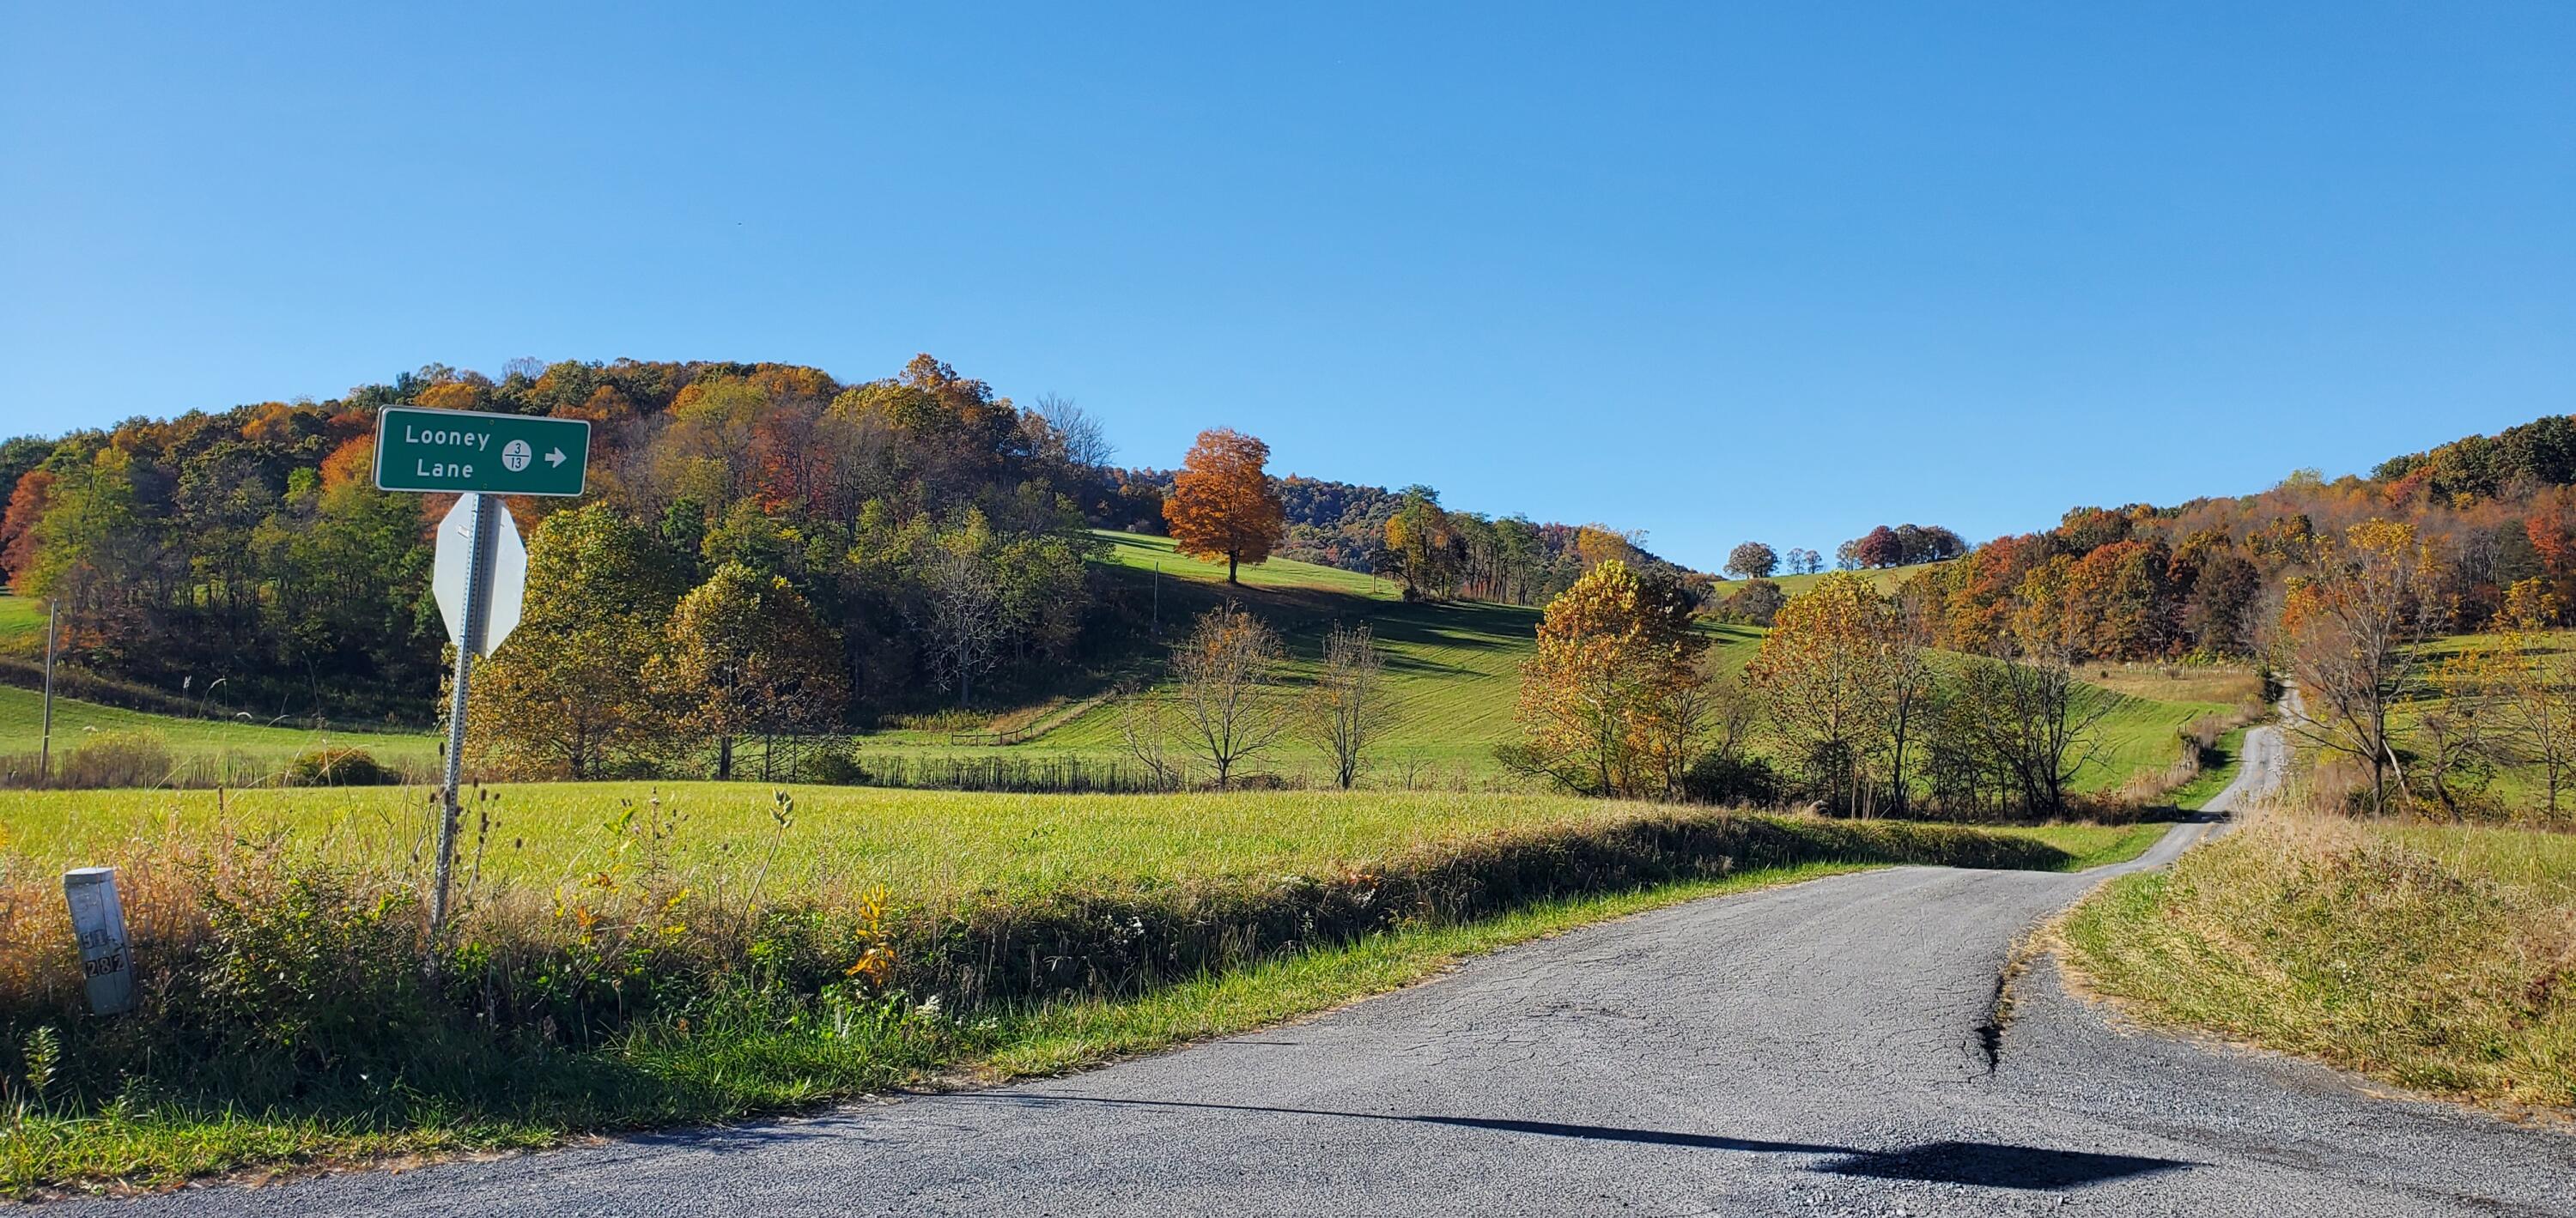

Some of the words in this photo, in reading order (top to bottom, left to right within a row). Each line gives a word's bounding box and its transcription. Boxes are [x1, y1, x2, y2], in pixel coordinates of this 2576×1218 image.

[406, 425, 490, 451] Looney
[514, 443, 521, 454] 3
[417, 458, 473, 477] Lane
[511, 458, 521, 469] 13
[87, 954, 125, 977] 282
